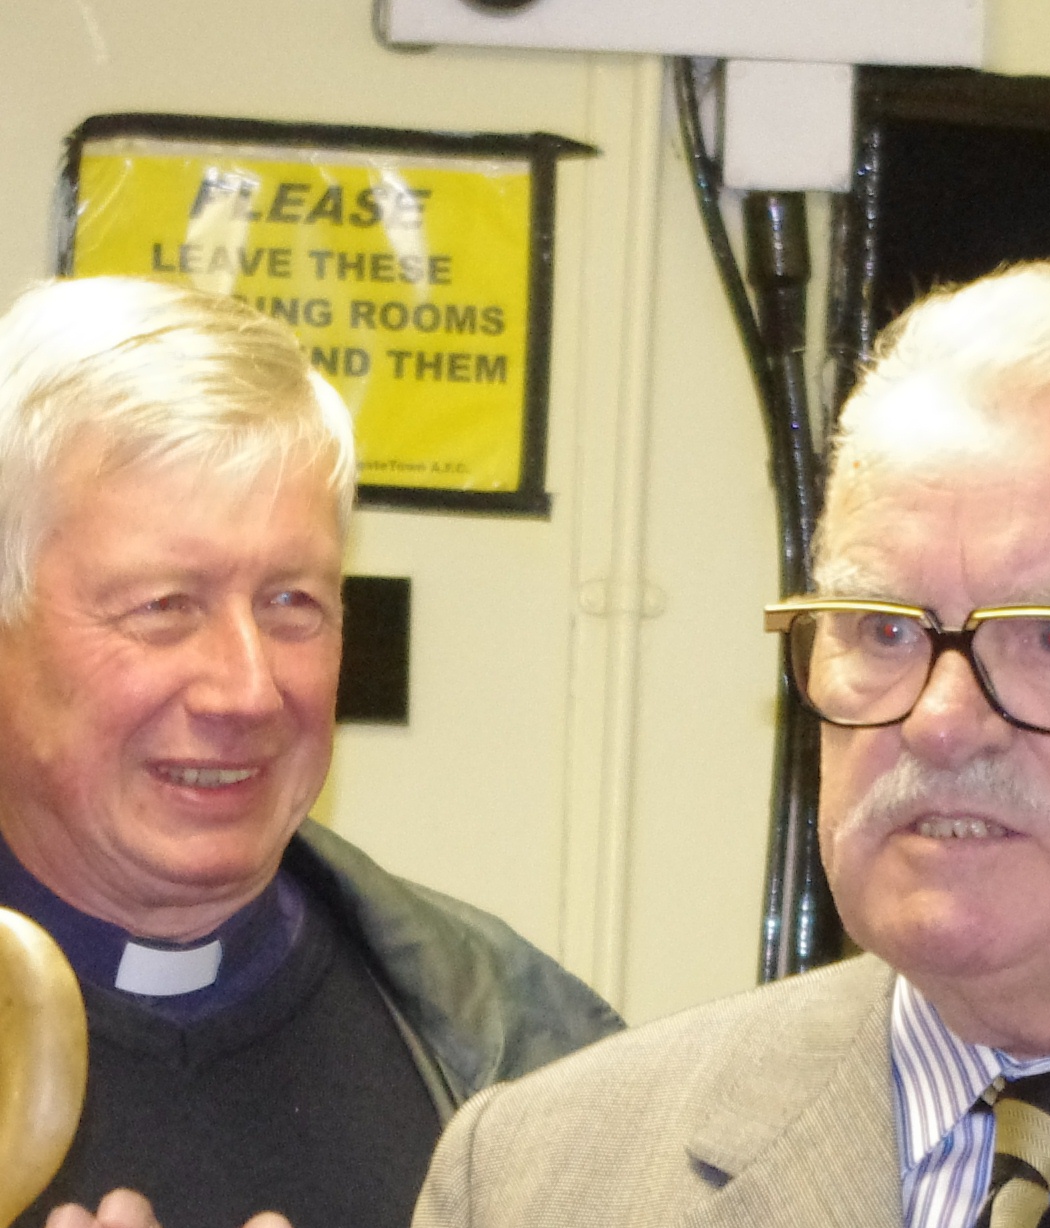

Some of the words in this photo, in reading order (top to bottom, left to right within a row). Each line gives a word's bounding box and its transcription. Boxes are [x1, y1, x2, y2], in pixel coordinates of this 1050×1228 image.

[190, 171, 431, 230] PLEASE
[152, 243, 290, 277] LEAVE
[308, 249, 453, 286] THESE
[238, 295, 332, 329] ING
[350, 299, 505, 336] ROOMS
[302, 346, 371, 378] ND
[387, 350, 508, 384] THEM
